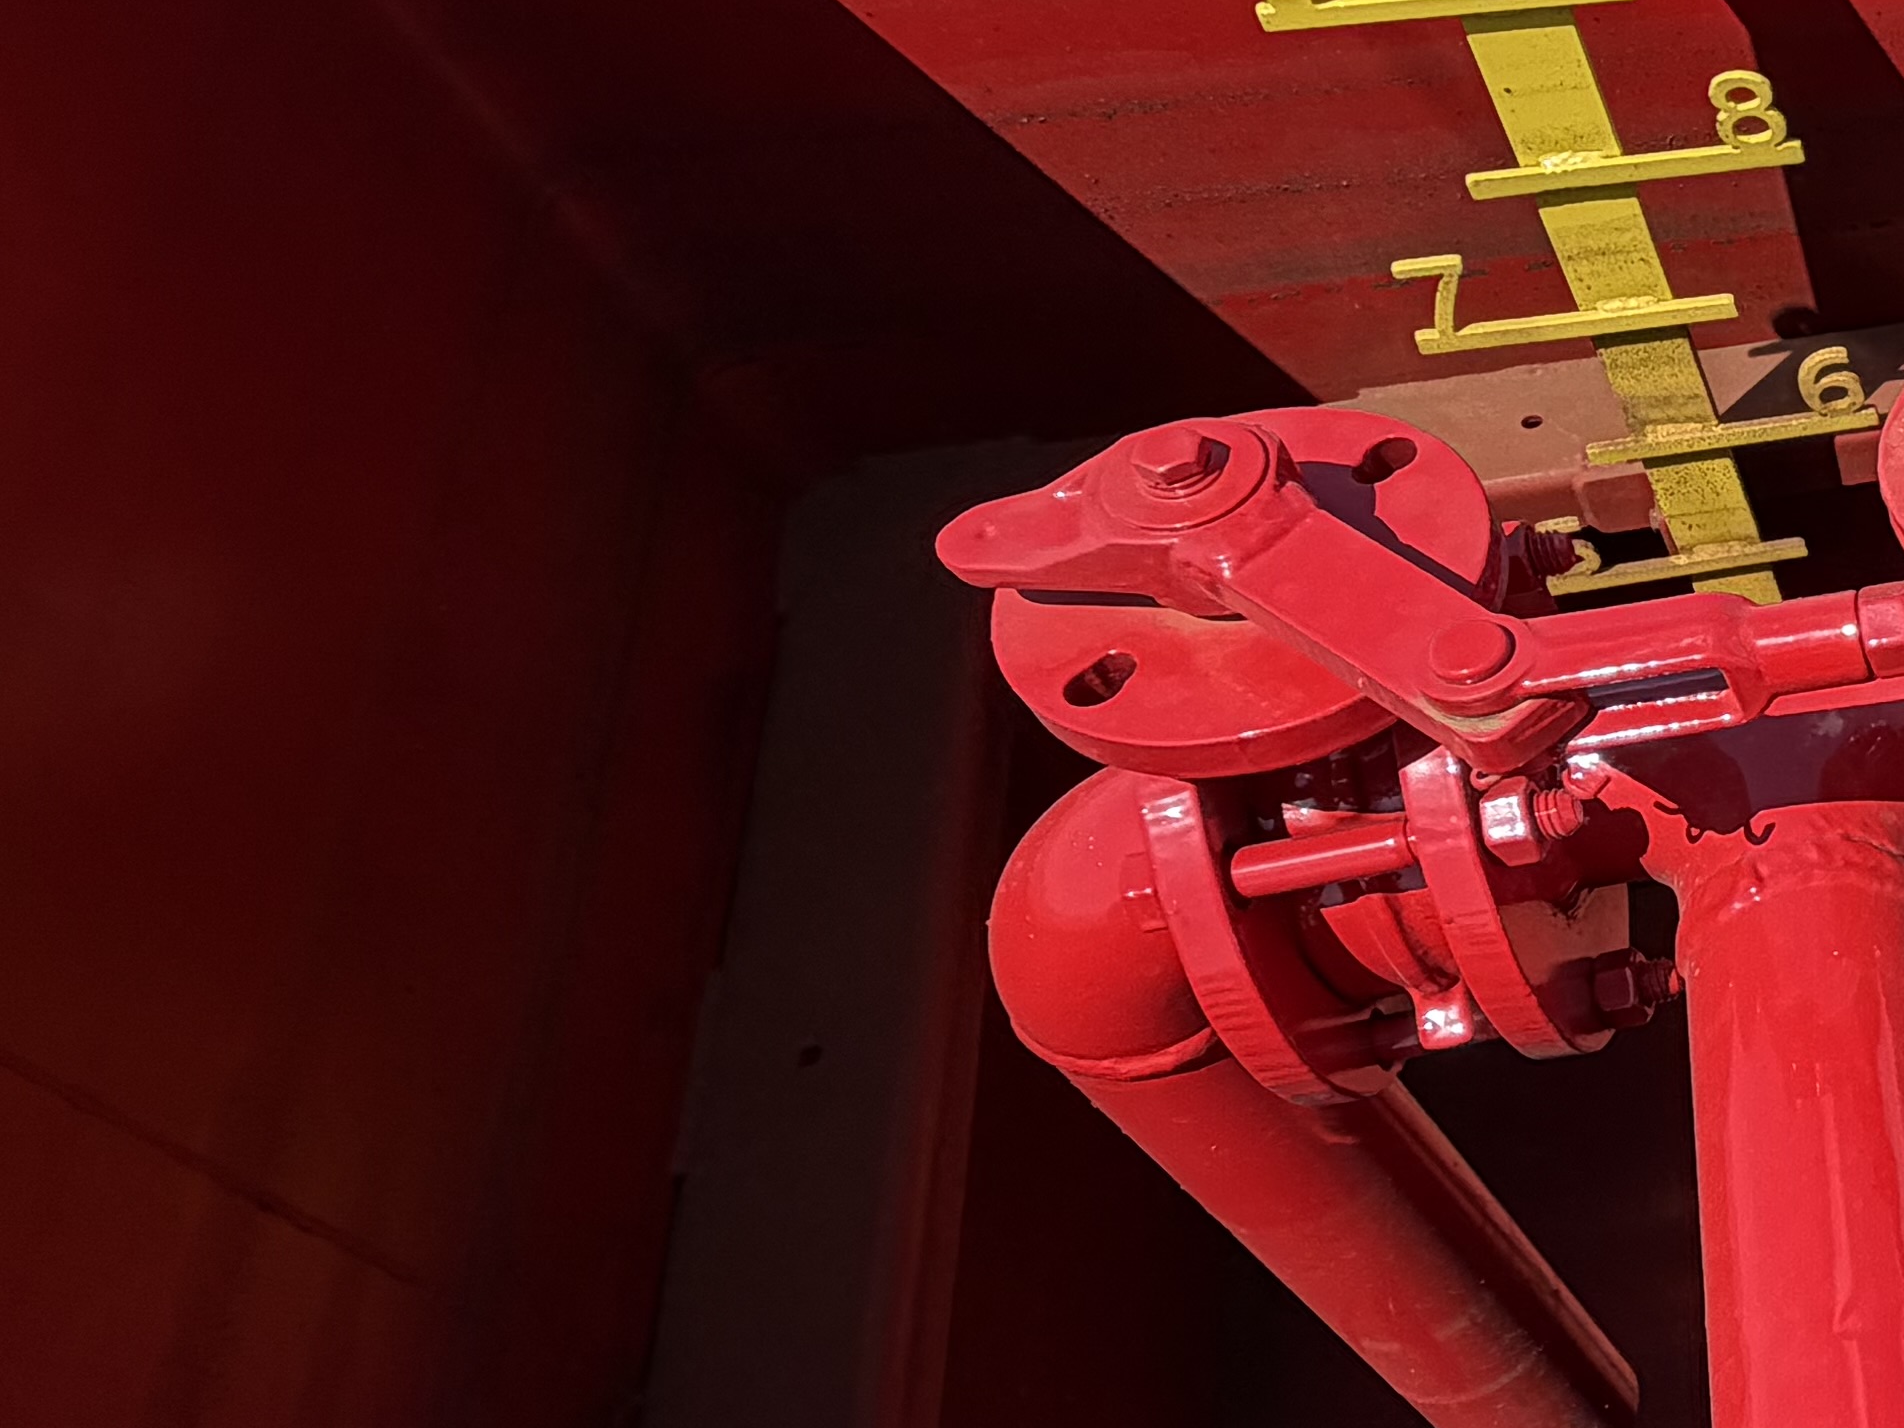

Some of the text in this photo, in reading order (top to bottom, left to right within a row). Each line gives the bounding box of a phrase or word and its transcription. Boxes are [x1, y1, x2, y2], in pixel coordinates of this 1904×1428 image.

[1708, 69, 1789, 151] 8
[1391, 254, 1463, 336] 7
[1797, 346, 1865, 414] 6
